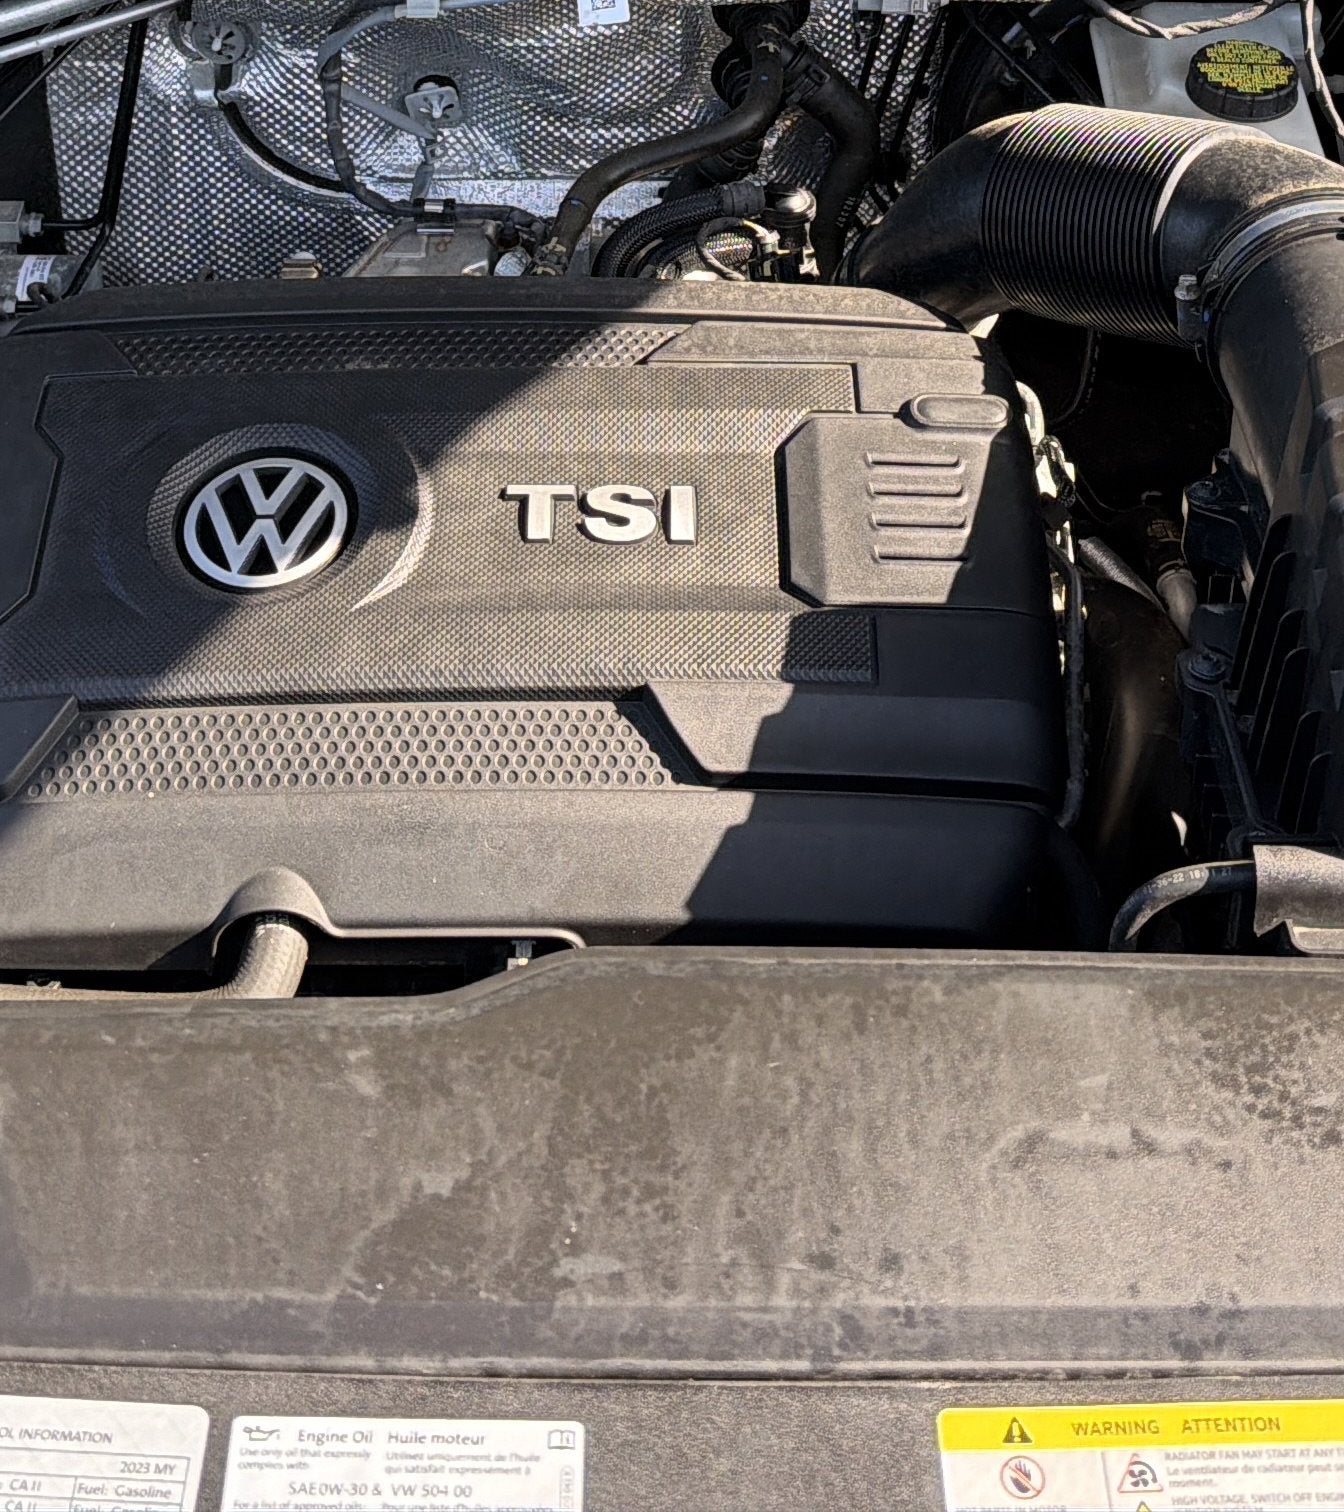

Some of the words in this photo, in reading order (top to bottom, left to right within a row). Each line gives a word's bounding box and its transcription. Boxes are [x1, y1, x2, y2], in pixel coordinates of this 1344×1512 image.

[505, 483, 697, 546] TSI
[1071, 1419, 1160, 1436] WARNING
[1181, 1417, 1281, 1435] ATTENTION
[18, 1427, 113, 1444] INFORMATION
[298, 1429, 348, 1446] Engine
[352, 1430, 373, 1444] Oil
[387, 1431, 427, 1445] Huile
[430, 1432, 485, 1445] moteur
[300, 1448, 321, 1458] that
[1164, 1450, 1216, 1461] RADIATOR
[1218, 1449, 1239, 1460] FAN
[1241, 1449, 1262, 1459] MAY
[1265, 1448, 1296, 1459] START
[1299, 1448, 1310, 1457] AT
[1313, 1448, 1334, 1457] ANY
[120, 1461, 151, 1474] 2023
[153, 1462, 177, 1475] MY
[1167, 1466, 1180, 1476] Le
[1241, 1463, 1255, 1474] de
[1257, 1463, 1304, 1473] radiateur
[1307, 1463, 1331, 1474] peut
[9, 1478, 28, 1492] CA
[76, 1482, 107, 1496] Fuel:
[114, 1484, 172, 1499] Gasoline
[371, 1483, 382, 1497] &
[389, 1483, 417, 1497] VW
[453, 1484, 474, 1498] 00
[1171, 1495, 1197, 1506] HIGH
[1251, 1493, 1291, 1504] SWITCH
[1293, 1492, 1312, 1503] OFF
